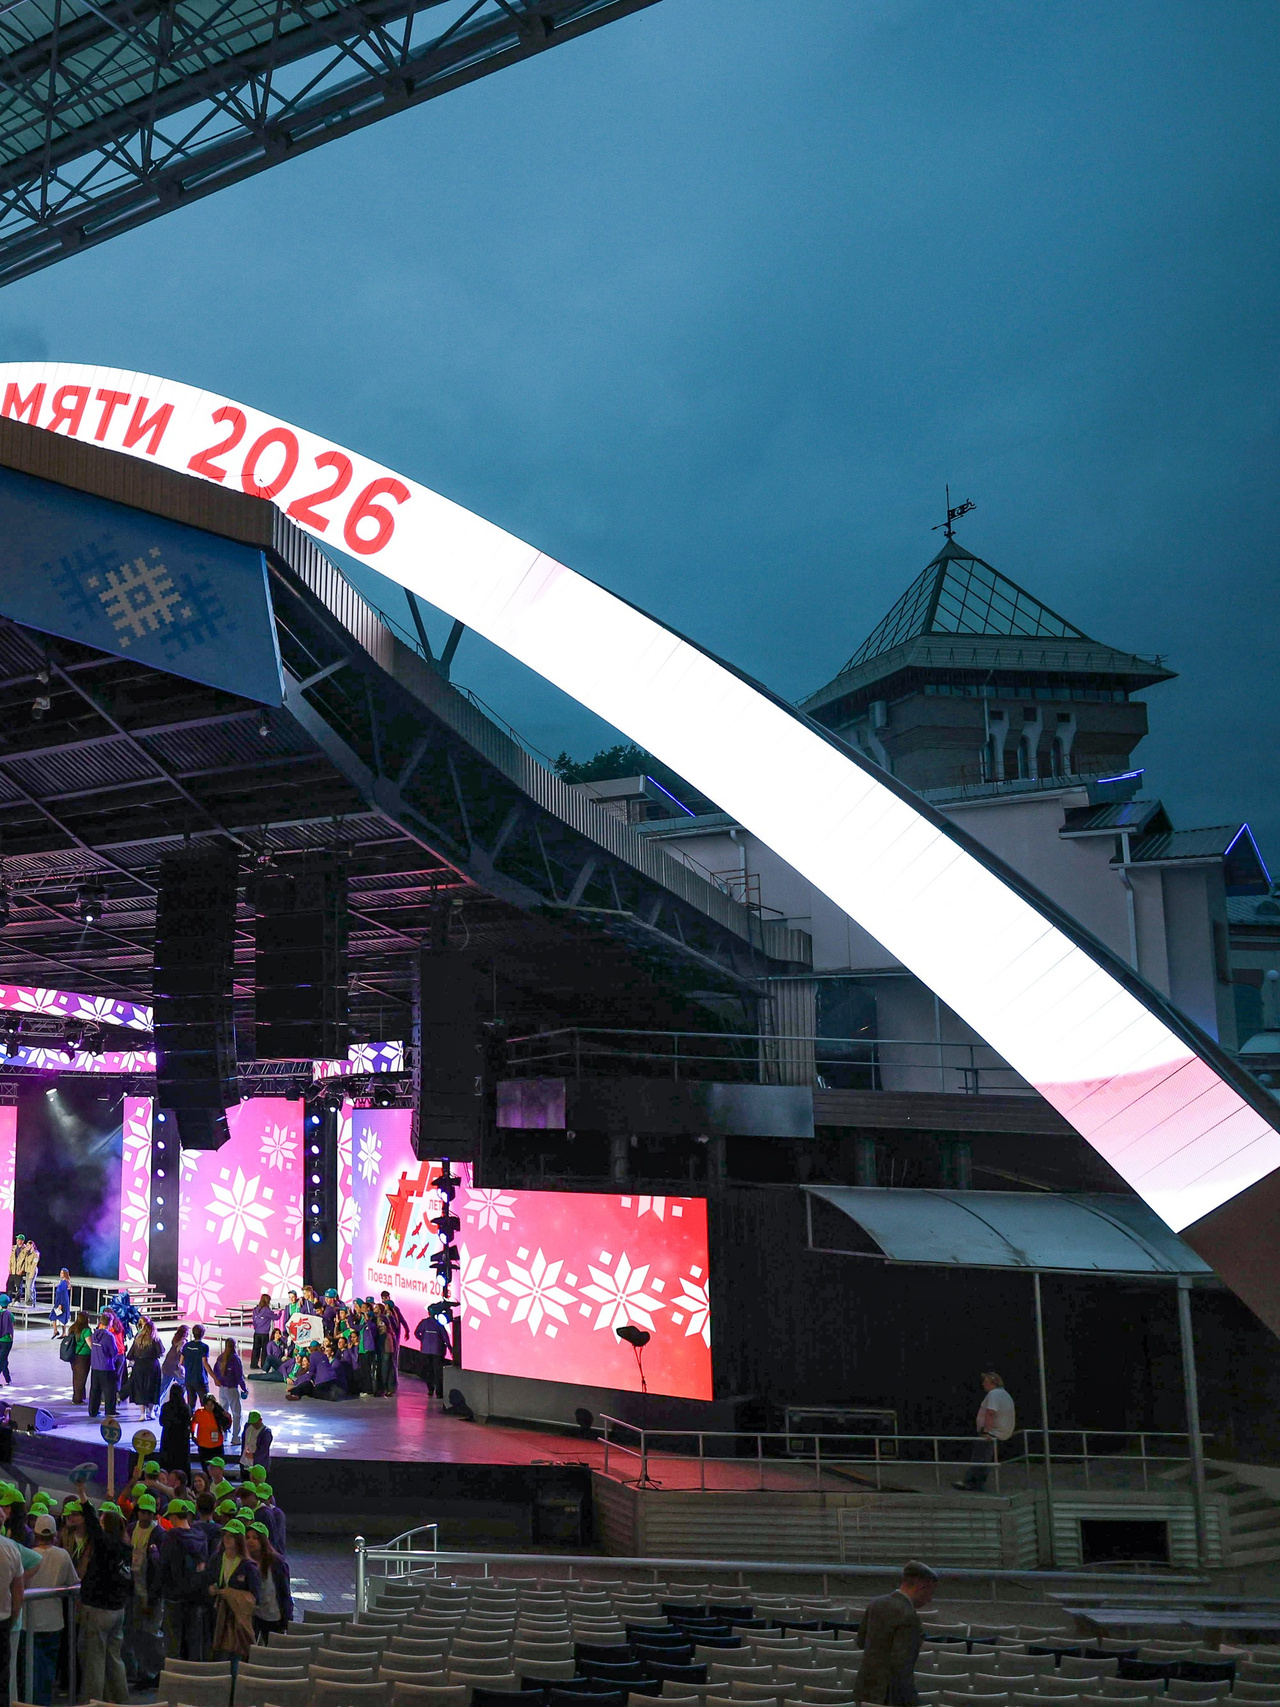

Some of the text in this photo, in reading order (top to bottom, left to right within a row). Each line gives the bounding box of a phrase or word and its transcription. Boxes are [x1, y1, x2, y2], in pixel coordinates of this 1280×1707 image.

[186, 406, 412, 555] 2026
[367, 1267, 452, 1299] Поезд Памяти 206
[103, 1428, 119, 1441] 2.2
[136, 1439, 151, 1450] 2.2
